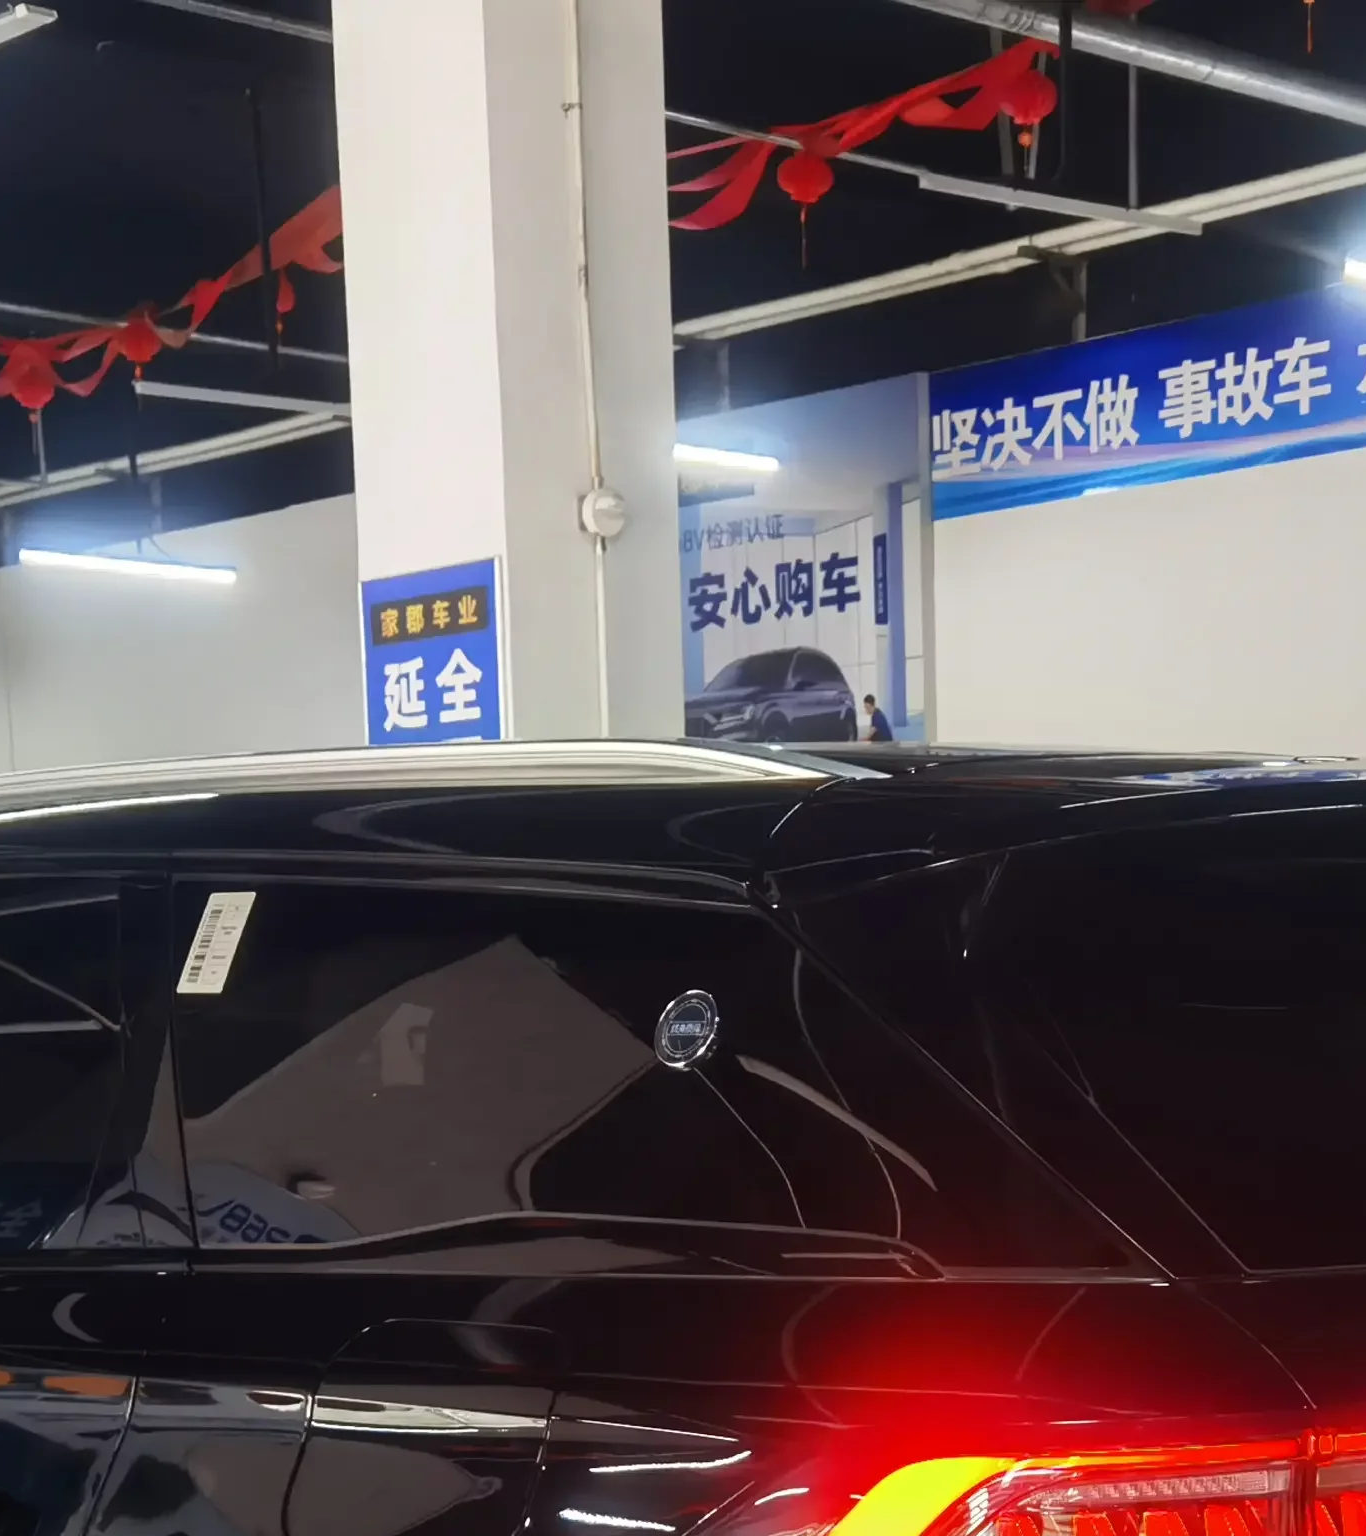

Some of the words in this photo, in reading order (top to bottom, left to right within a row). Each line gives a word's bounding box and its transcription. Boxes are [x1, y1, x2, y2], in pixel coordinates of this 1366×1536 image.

[932, 373, 1139, 478] 坚决不做
[1157, 337, 1333, 440] 事故车
[680, 513, 785, 553] 8V检测认证
[379, 594, 479, 638] 家郡车业
[687, 551, 862, 633] 安心购车
